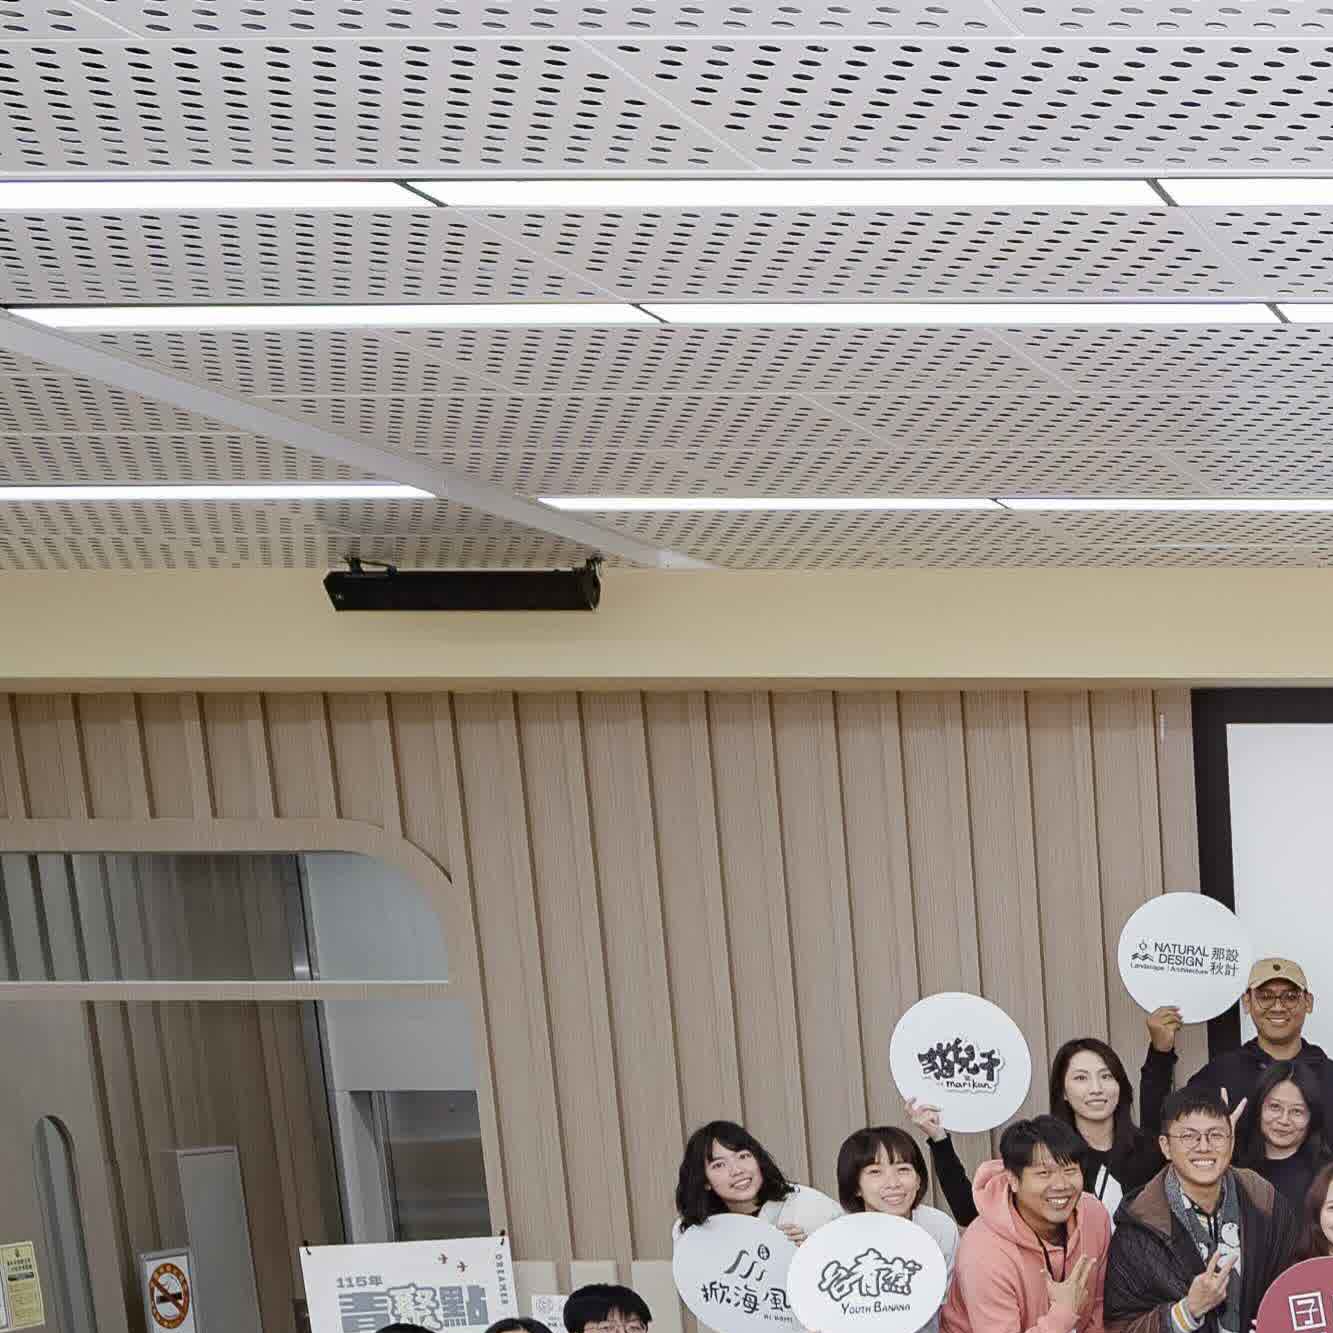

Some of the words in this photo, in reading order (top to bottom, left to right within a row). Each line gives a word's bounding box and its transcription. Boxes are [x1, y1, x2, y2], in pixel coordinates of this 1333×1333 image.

[1154, 942, 1209, 957] NATURAL
[1158, 953, 1204, 967] DESIGN
[336, 1274, 383, 1289] 115年
[701, 1281, 792, 1315] 掀海風
[841, 1301, 870, 1315] YOUTH
[873, 1301, 911, 1313] BANANA
